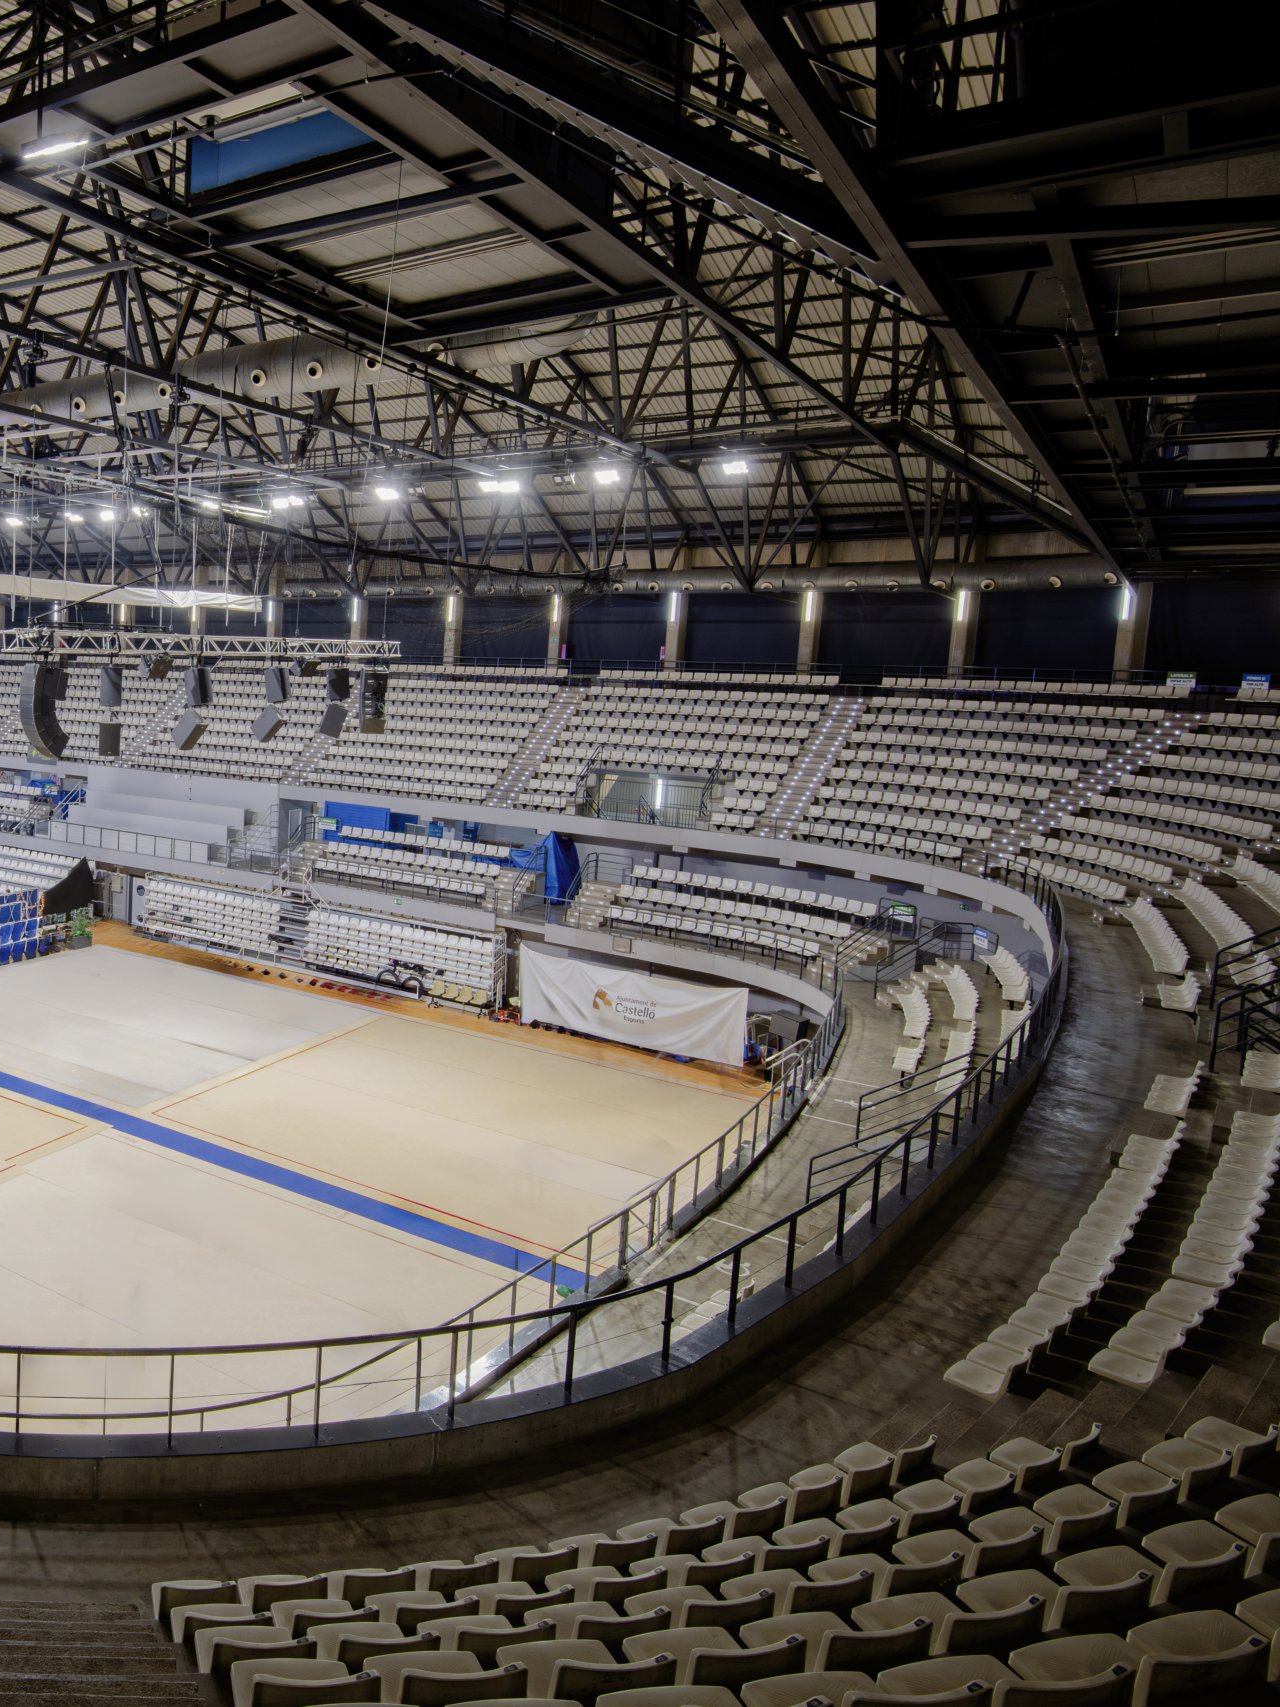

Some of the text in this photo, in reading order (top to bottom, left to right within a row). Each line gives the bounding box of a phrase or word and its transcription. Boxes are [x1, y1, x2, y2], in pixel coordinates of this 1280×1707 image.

[615, 995, 649, 1006] Ajuntament
[614, 1002, 656, 1020] Castelló
[623, 1015, 645, 1024] Esports
